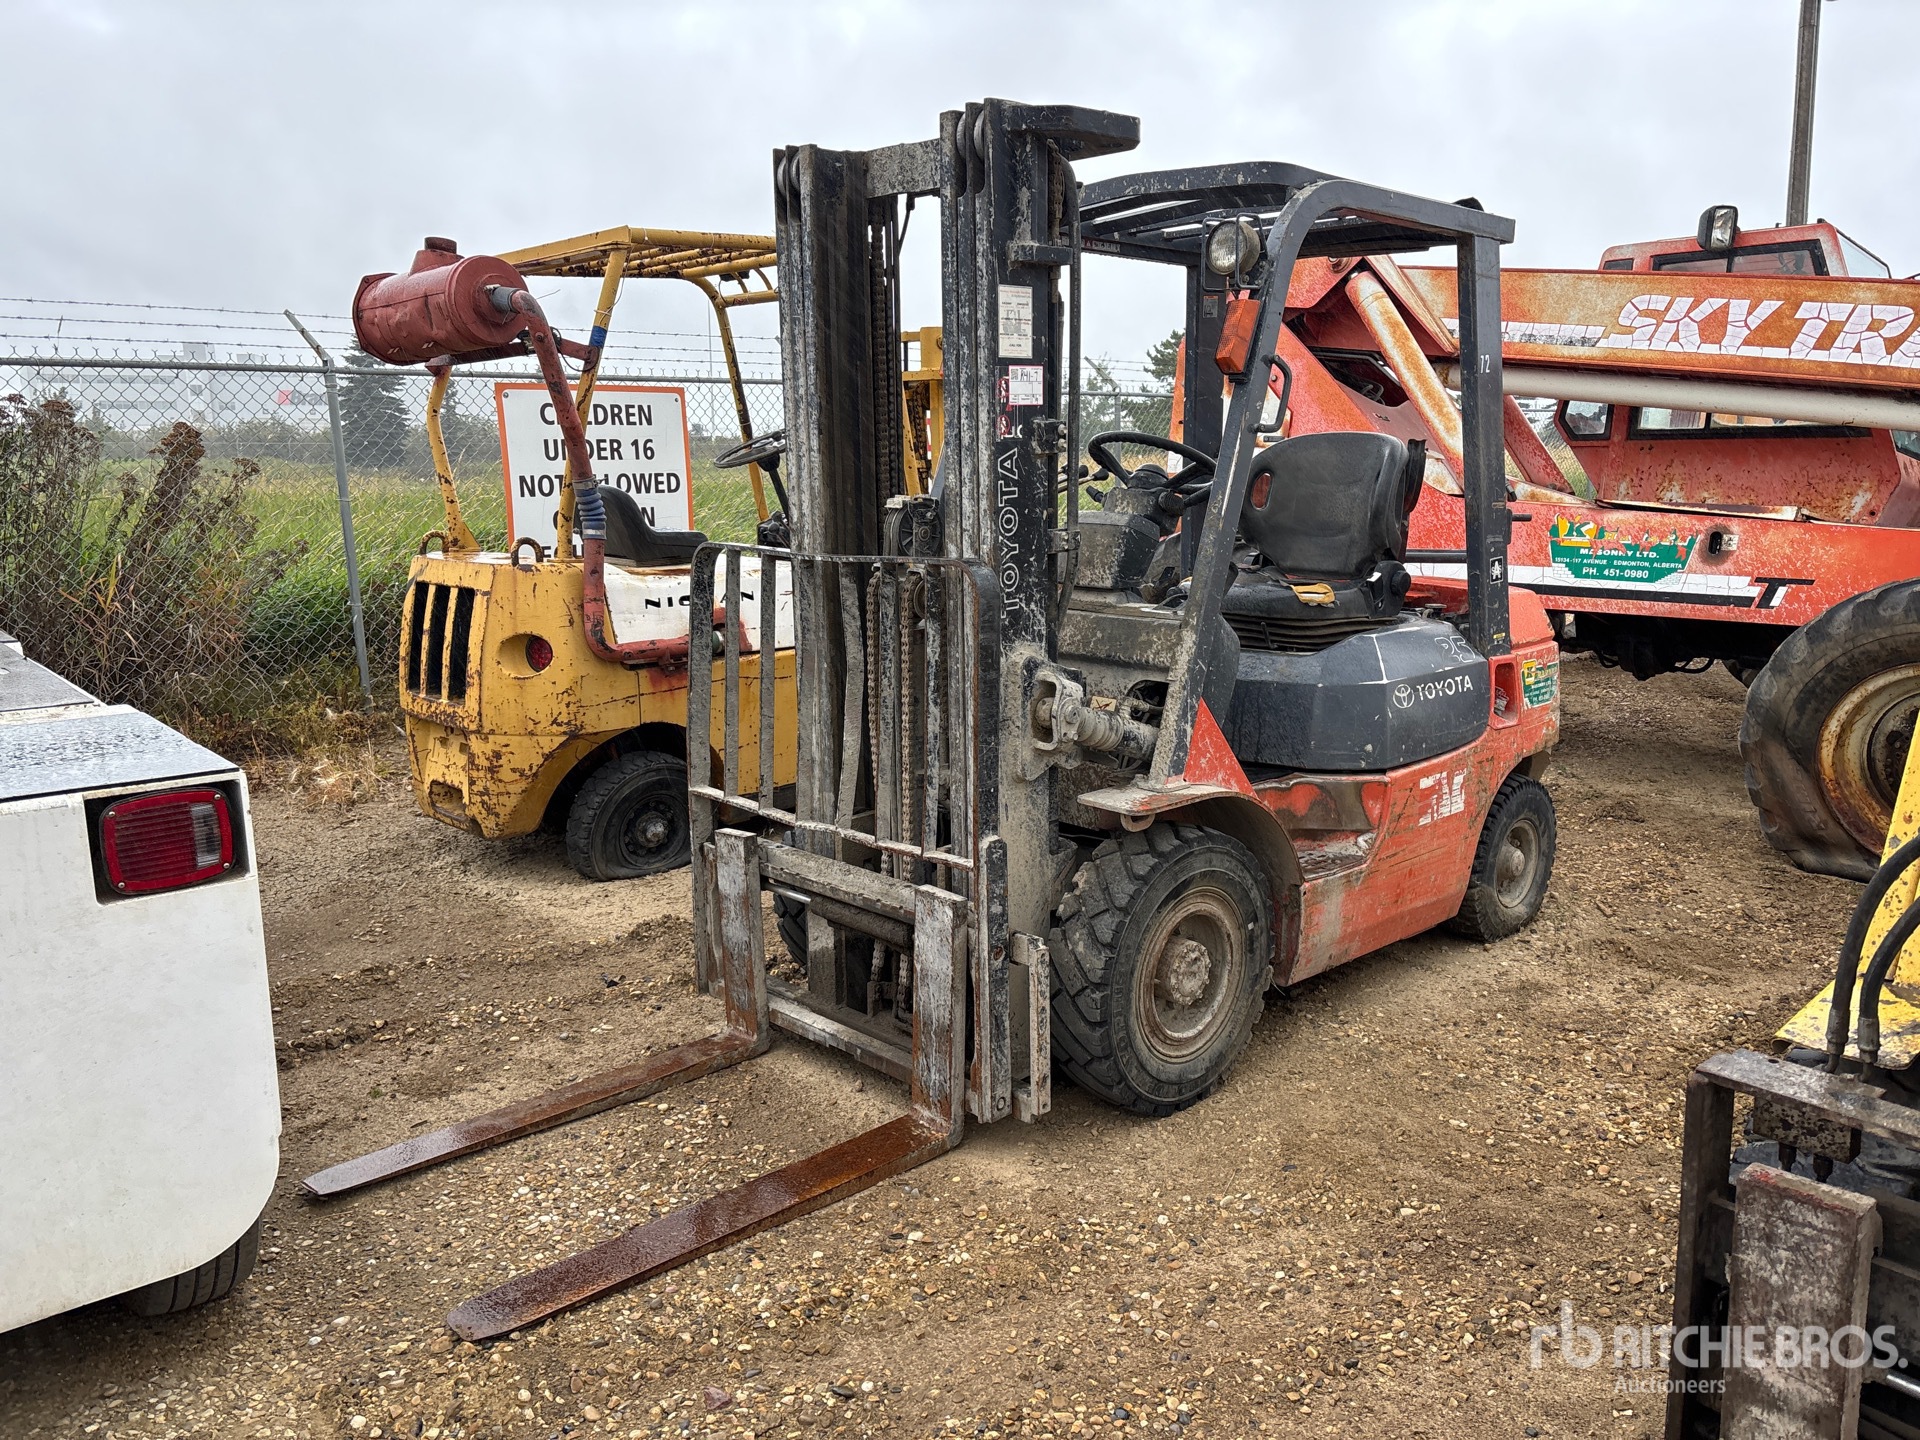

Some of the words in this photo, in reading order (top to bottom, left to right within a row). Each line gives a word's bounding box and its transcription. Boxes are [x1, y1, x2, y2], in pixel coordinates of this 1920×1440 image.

[1480, 355, 1490, 374] 12
[631, 438, 655, 460] 16
[998, 447, 1020, 619] TOYOTA
[1636, 550, 1660, 558] LTD.
[1582, 566, 1600, 576] PH.
[1603, 568, 1649, 579] 451-0980
[1613, 560, 1651, 568] EDMONTON,
[1416, 674, 1474, 701] TOYOTA
